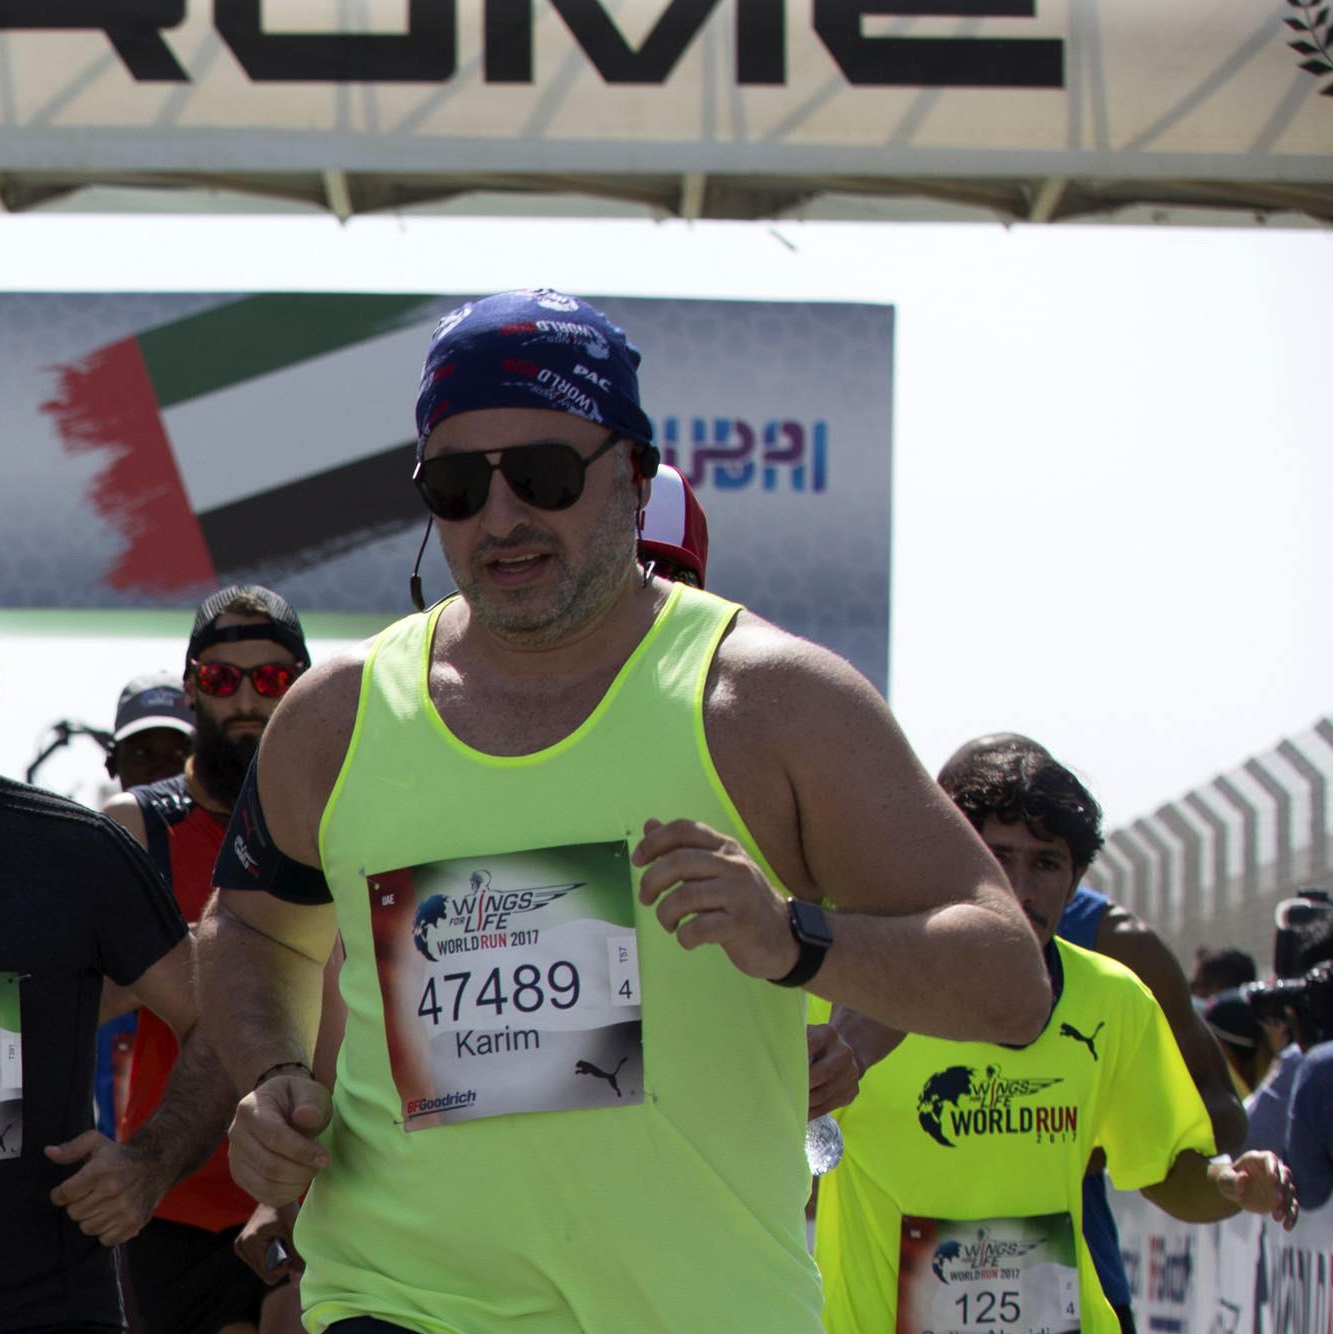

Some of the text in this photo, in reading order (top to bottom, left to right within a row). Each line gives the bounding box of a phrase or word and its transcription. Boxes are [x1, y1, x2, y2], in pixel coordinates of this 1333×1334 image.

[651, 416, 827, 494] UBAI
[452, 891, 534, 916] WINGS
[449, 912, 512, 933] FOR LIFE
[437, 930, 540, 955] WORLD RUN 2017
[417, 961, 581, 1025] 47489
[618, 979, 633, 999] 4
[455, 1026, 540, 1058] Karim
[972, 1081, 1030, 1096] WINGS
[406, 1090, 477, 1114] BFGoodrich
[950, 1106, 1078, 1136] WORLD RUN
[1037, 1134, 1078, 1144] 2017
[964, 1242, 1017, 1257] WINGS
[950, 1271, 980, 1282] WORLD
[1000, 1269, 1021, 1279] 2017
[954, 1291, 1022, 1326] 125
[1066, 1301, 1075, 1316] 4
